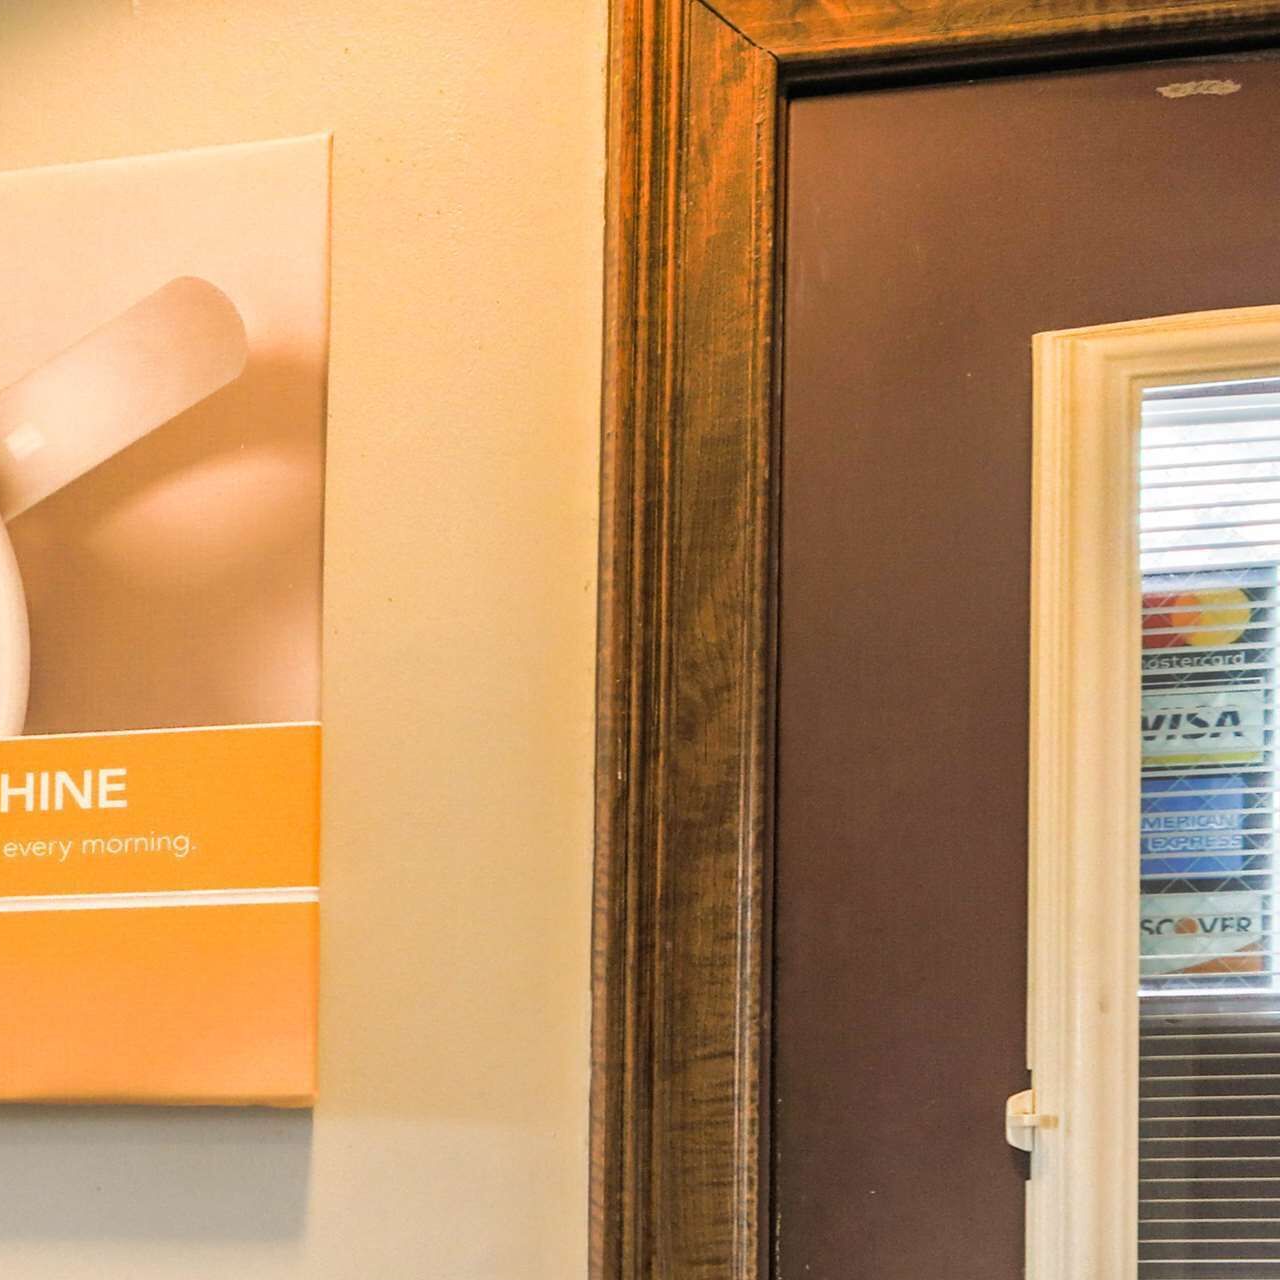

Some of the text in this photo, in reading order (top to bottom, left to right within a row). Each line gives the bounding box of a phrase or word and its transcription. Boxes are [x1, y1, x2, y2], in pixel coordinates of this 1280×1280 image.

[1141, 704, 1243, 741] VISA
[3, 840, 73, 864] every
[81, 831, 197, 858] morning.
[1149, 835, 1243, 852] EXPRESS
[1140, 916, 1252, 936] SCOVER
